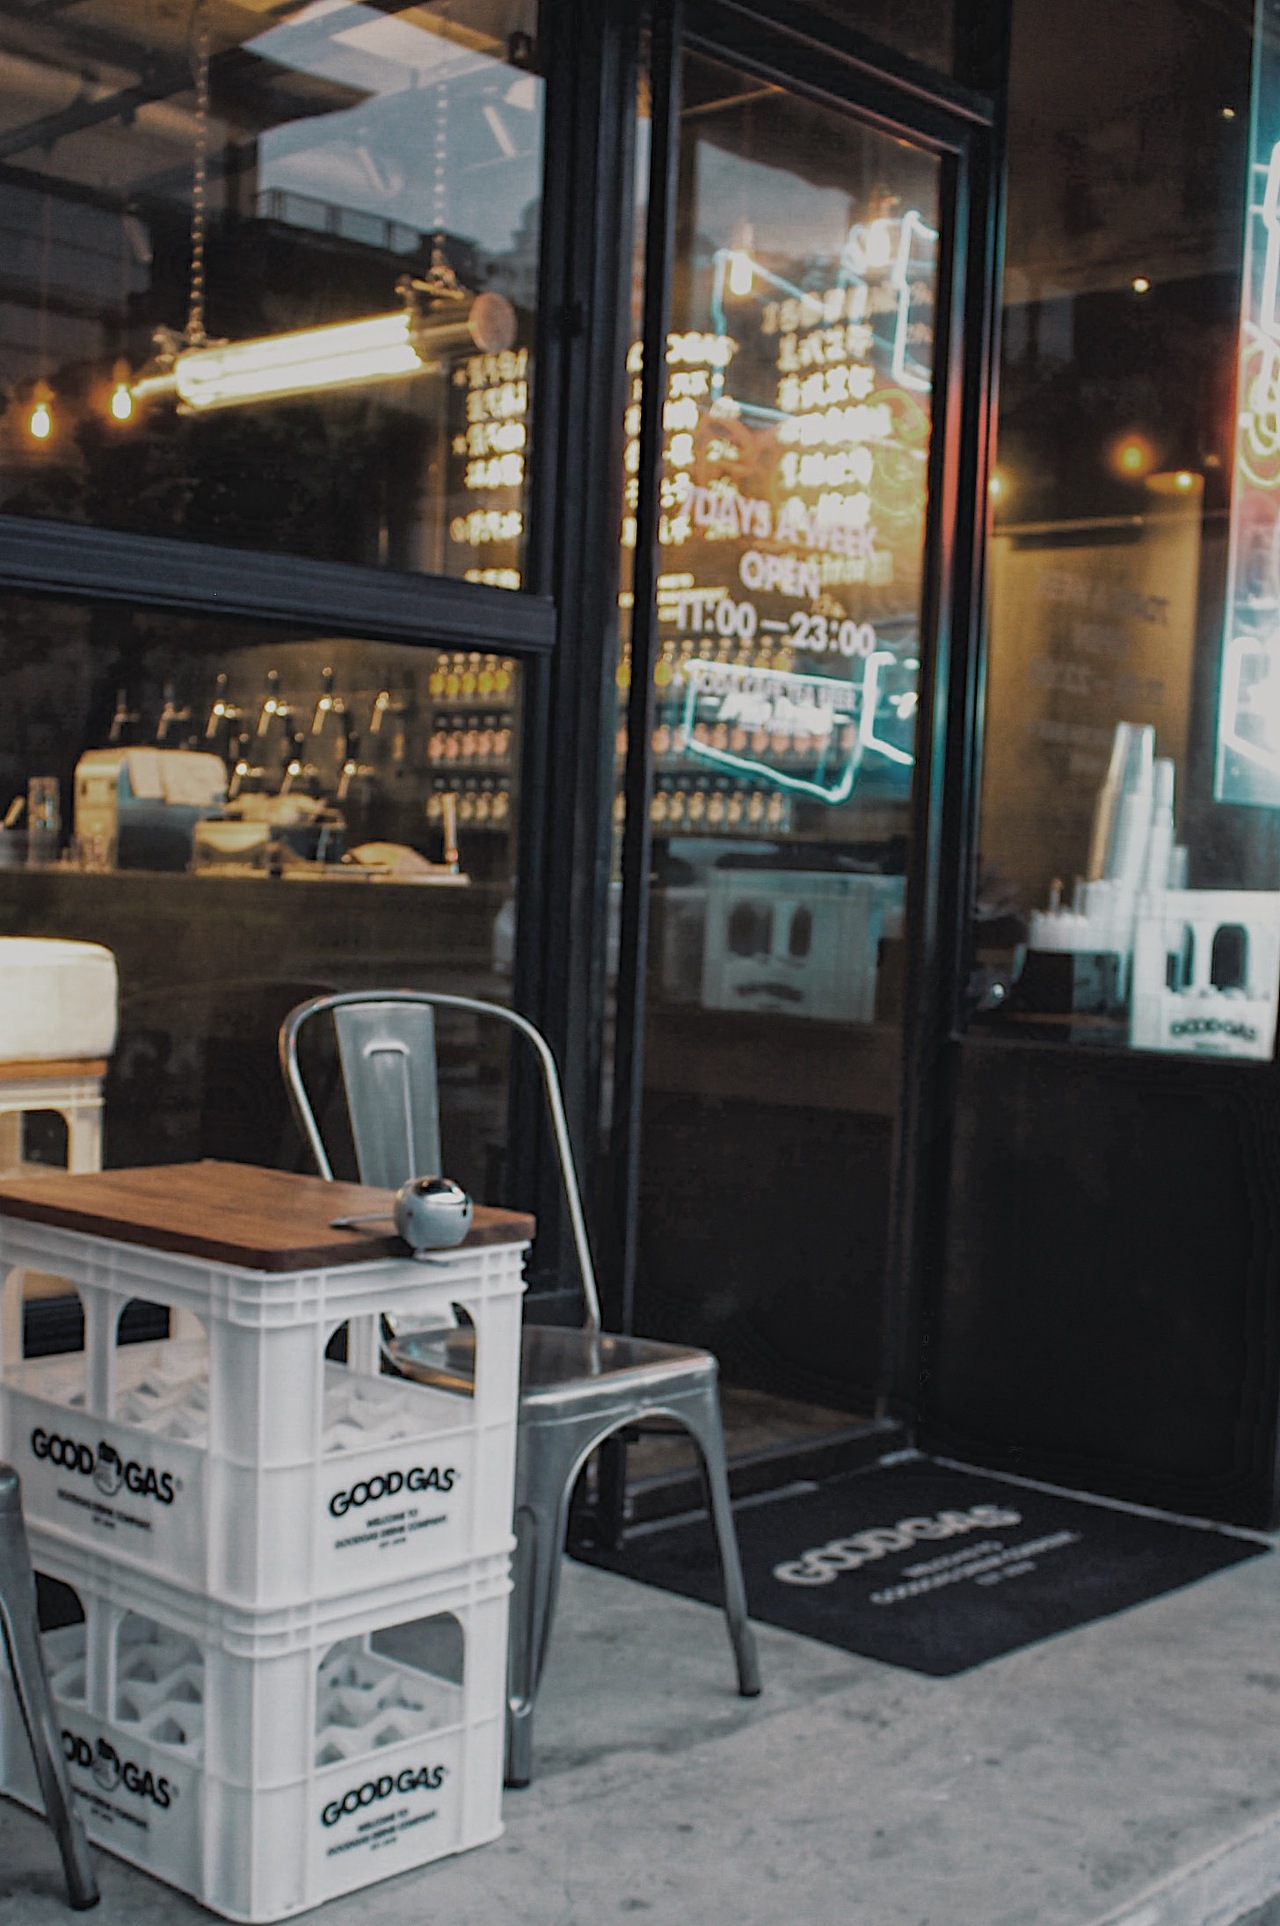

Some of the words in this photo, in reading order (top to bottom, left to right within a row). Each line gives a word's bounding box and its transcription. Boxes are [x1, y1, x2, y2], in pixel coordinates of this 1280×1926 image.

[739, 551, 821, 600] OPEN
[31, 1428, 94, 1475] GOOD
[124, 1462, 175, 1505] GAS
[123, 1762, 171, 1809] GAS
